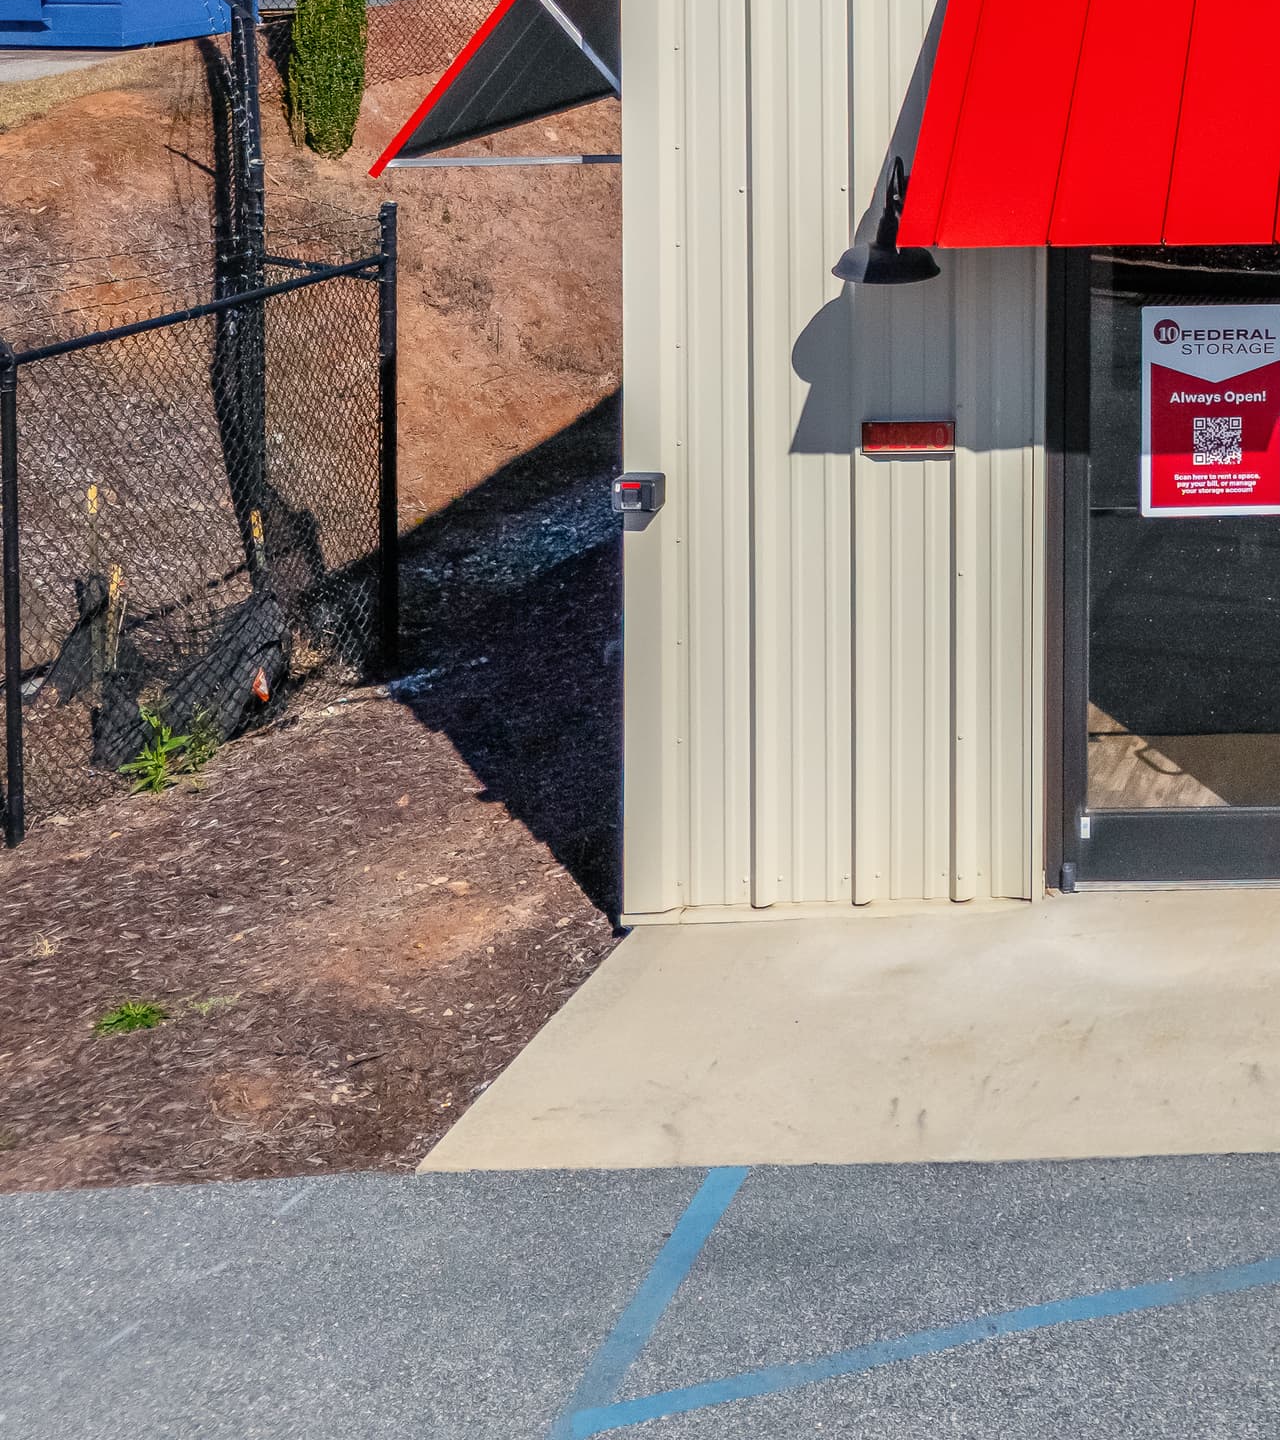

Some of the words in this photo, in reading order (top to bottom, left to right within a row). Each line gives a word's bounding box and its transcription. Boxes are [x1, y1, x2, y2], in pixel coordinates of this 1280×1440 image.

[1157, 326, 1179, 342] 10
[1181, 328, 1276, 341] FEDERAL
[1181, 342, 1275, 355] STORAGE
[1170, 391, 1221, 406] Always
[1224, 390, 1267, 405] Open!
[1174, 473, 1192, 481] Scan
[1229, 480, 1257, 488] manage
[1181, 488, 1197, 496] your
